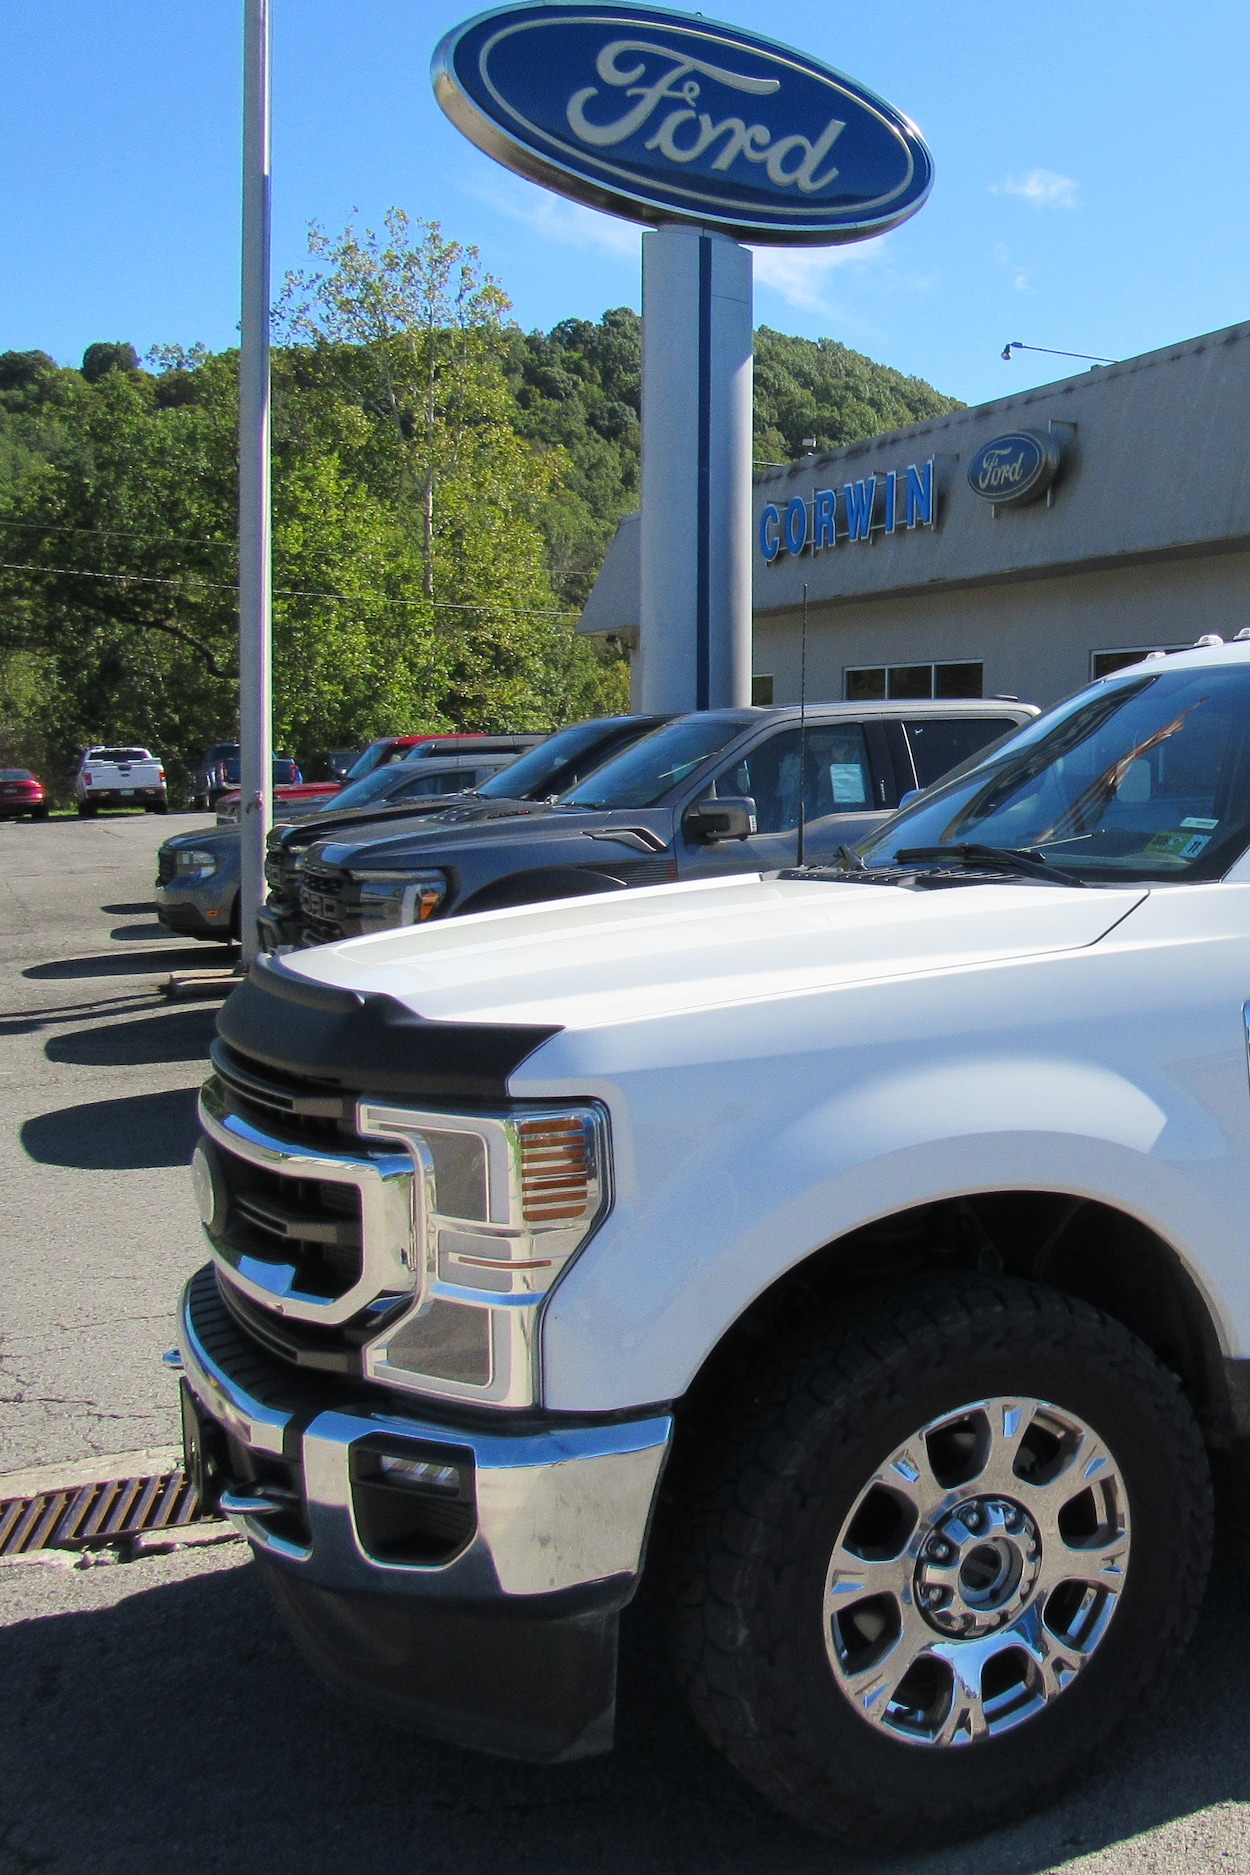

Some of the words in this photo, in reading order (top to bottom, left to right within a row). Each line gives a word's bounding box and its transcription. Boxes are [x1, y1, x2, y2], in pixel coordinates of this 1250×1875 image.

[566, 40, 846, 193] Ford
[759, 459, 935, 562] CORWIN
[978, 446, 1024, 489] Ford
